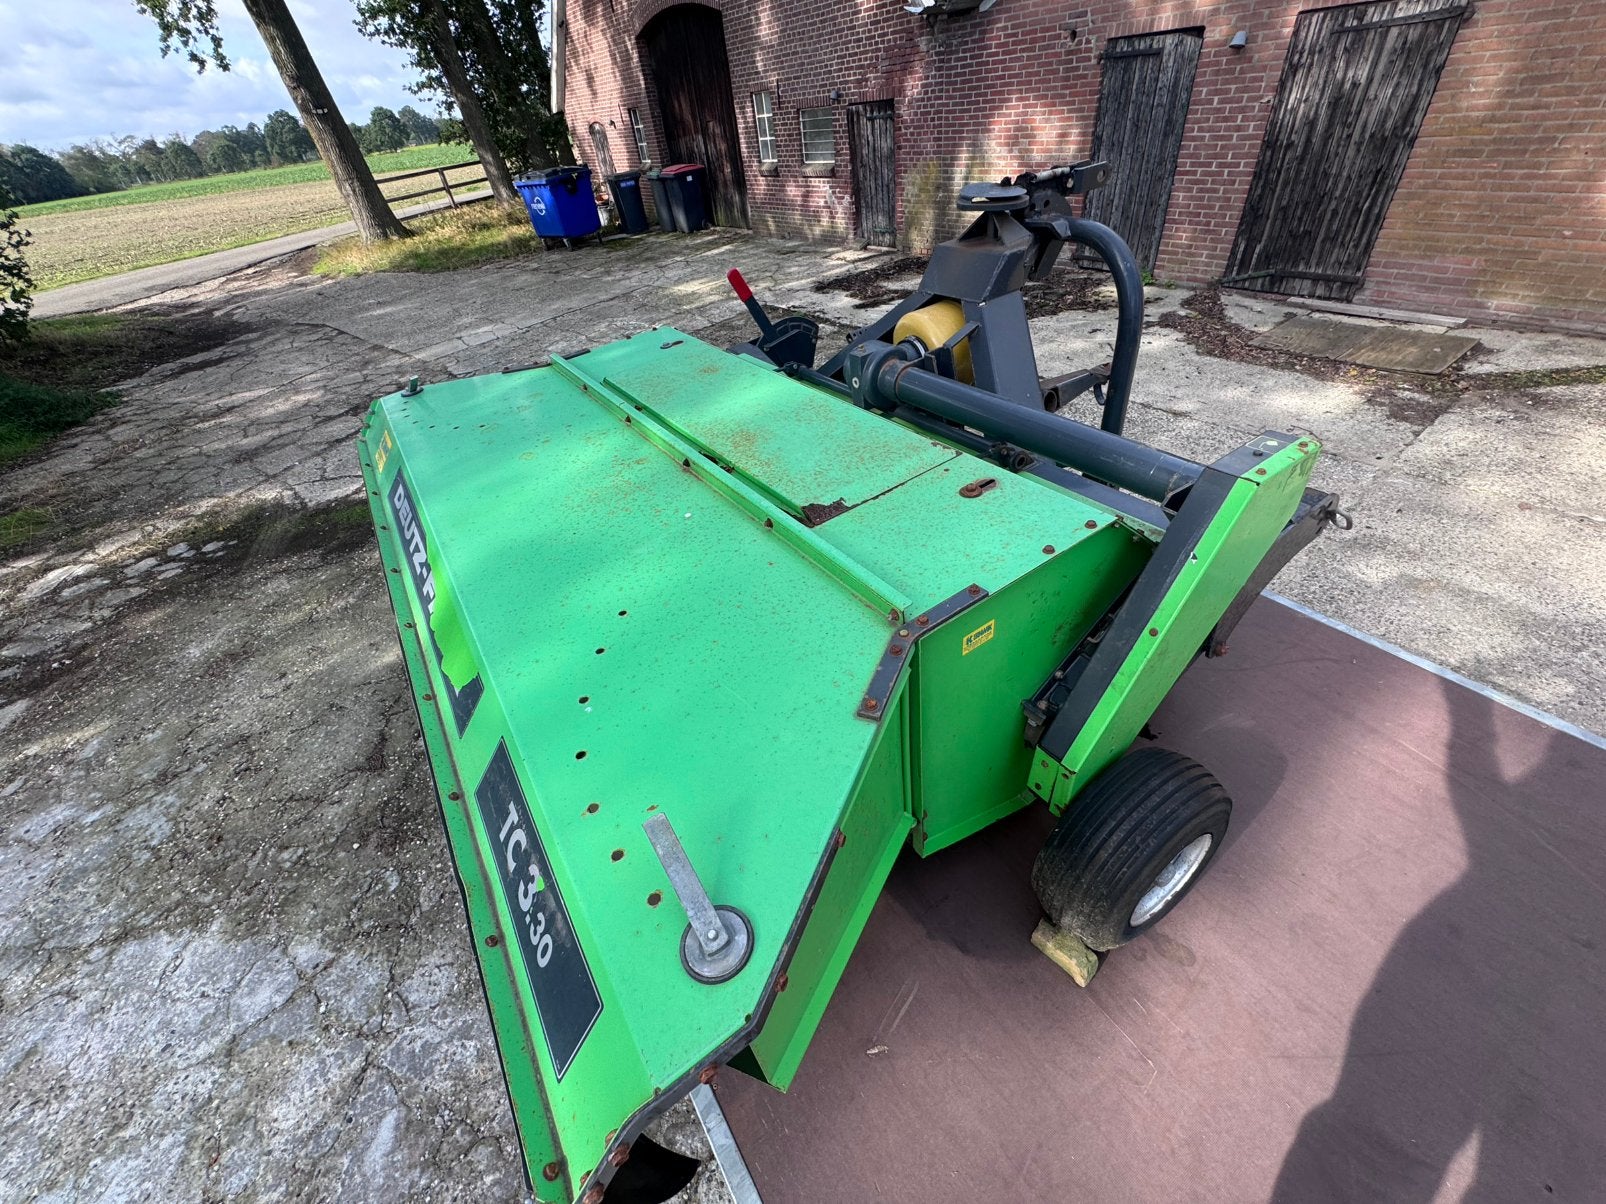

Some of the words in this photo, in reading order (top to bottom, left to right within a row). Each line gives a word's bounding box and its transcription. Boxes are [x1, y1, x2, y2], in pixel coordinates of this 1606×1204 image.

[393, 483, 436, 615] DEUTZ-F
[499, 800, 527, 873] TC
[518, 863, 553, 968] 3.30
